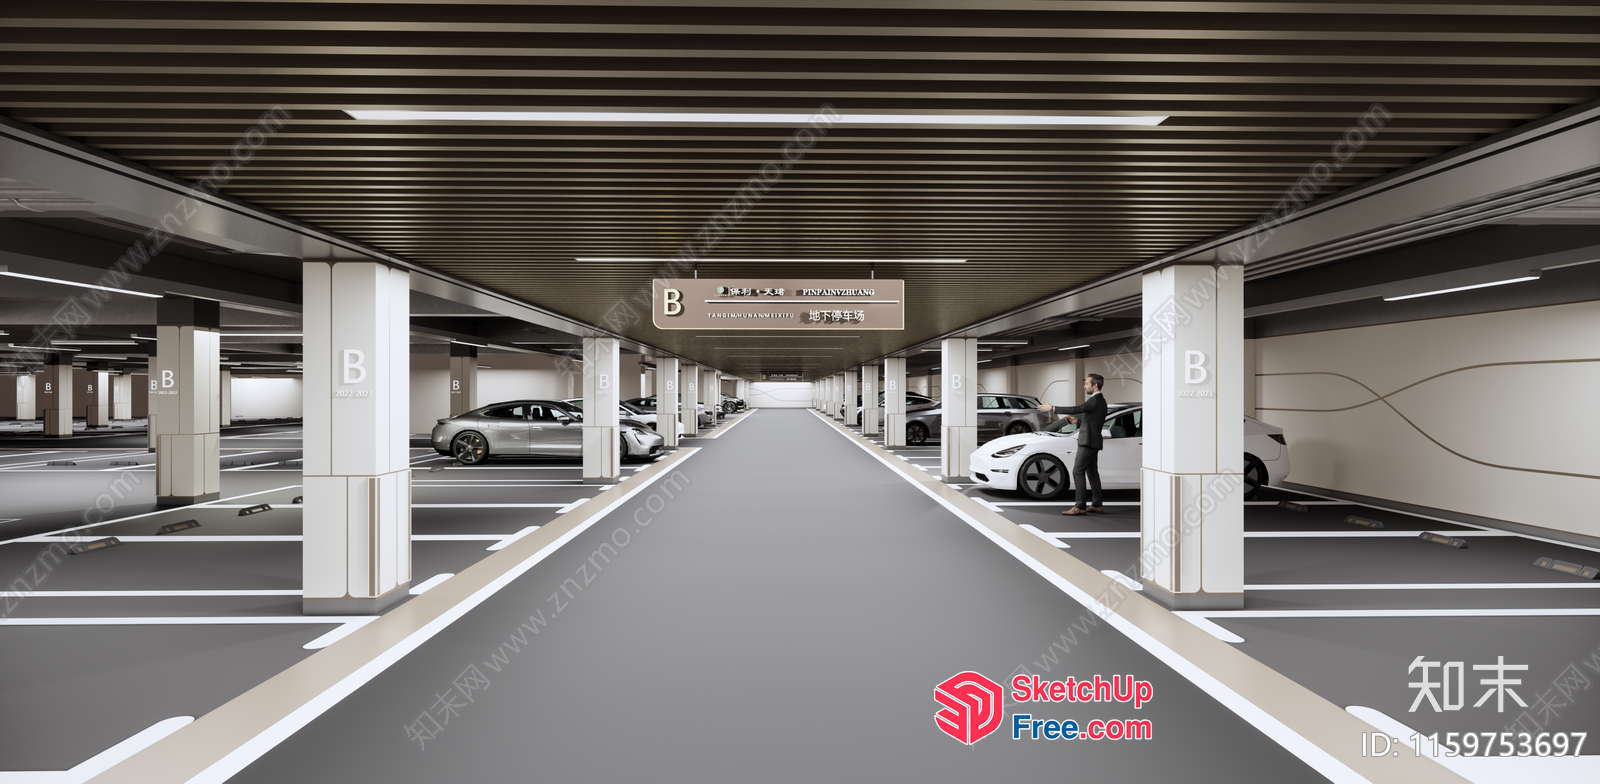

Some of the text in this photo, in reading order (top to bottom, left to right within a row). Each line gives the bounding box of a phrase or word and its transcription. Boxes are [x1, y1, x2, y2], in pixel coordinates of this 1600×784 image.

[802, 288, 875, 296] PINPAINVZHUANG
[664, 289, 681, 315] B
[808, 309, 865, 322] 地下停车场
[343, 349, 367, 384] B
[1184, 350, 1207, 384] B
[162, 370, 175, 388] B
[599, 373, 610, 389] B
[952, 373, 962, 389] B
[45, 382, 52, 391] B
[150, 379, 158, 391] B
[452, 380, 460, 391] B
[666, 380, 674, 391] B
[688, 382, 695, 391] B
[709, 384, 715, 392] B
[846, 384, 852, 392] B
[865, 382, 871, 391] B
[889, 380, 897, 391] B
[335, 389, 373, 397] 2022-2023
[1177, 389, 1213, 397] 2022-2023
